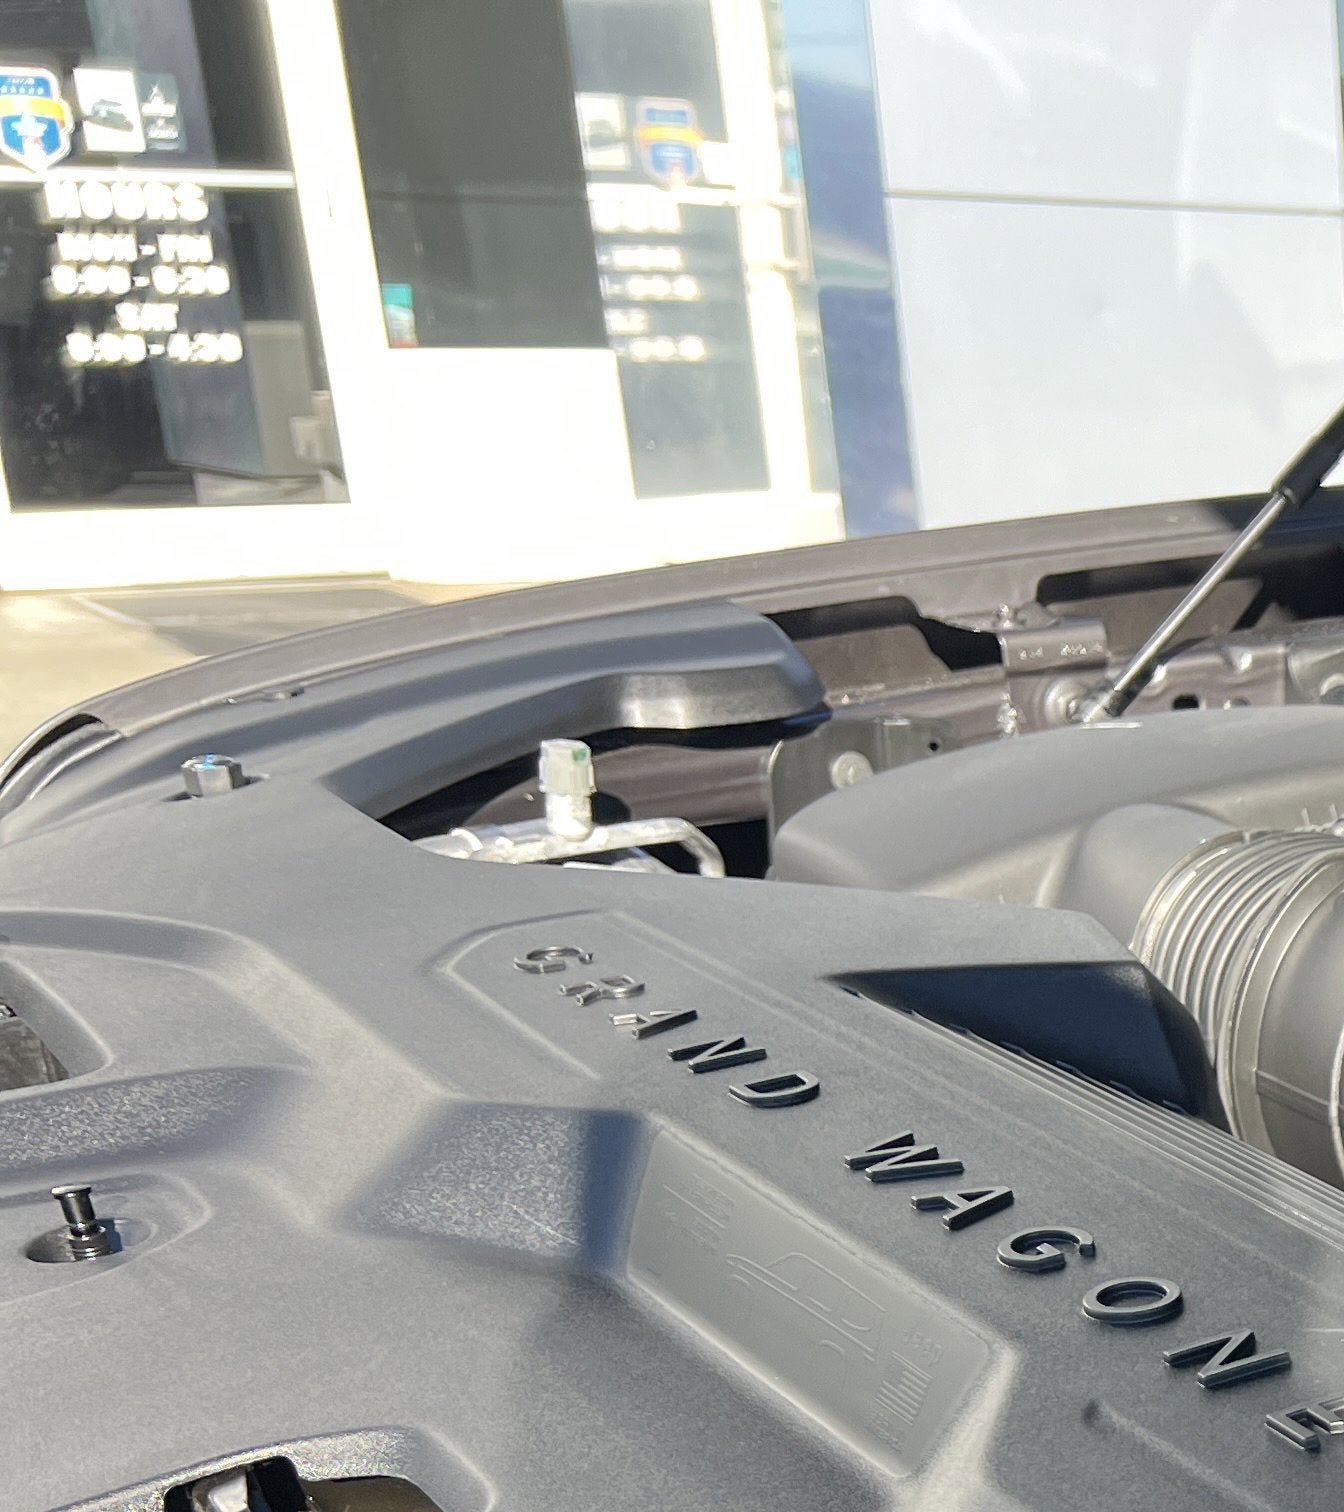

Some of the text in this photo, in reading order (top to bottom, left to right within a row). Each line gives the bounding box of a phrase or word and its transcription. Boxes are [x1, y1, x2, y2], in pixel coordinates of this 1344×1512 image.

[44, 182, 208, 220] HOURS
[115, 302, 179, 330] SAT
[513, 943, 820, 1109] GRAND
